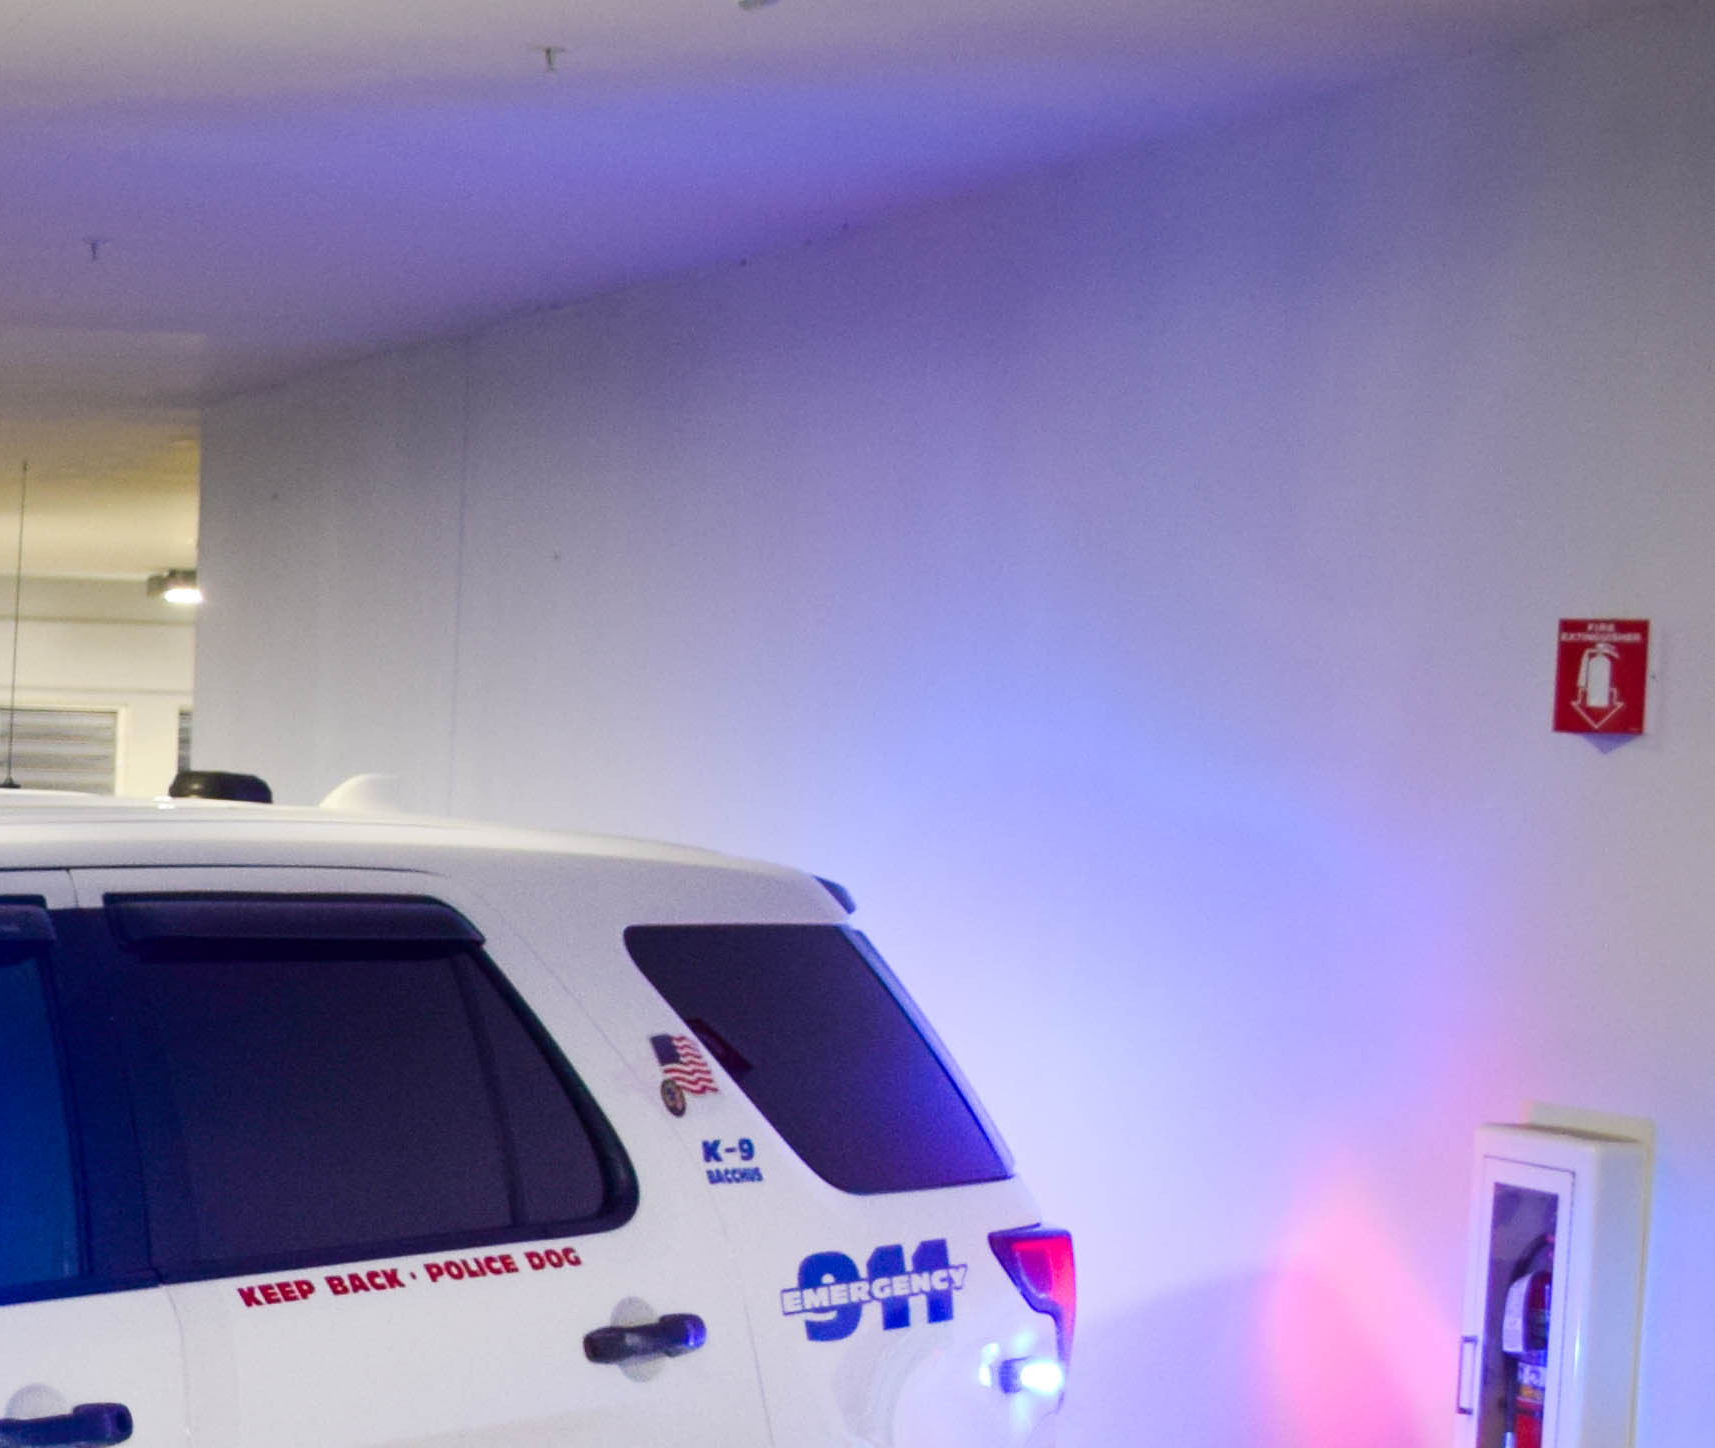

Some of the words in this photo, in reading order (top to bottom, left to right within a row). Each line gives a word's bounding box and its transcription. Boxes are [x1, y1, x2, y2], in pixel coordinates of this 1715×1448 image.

[702, 1137, 755, 1162] K-9
[237, 1279, 316, 1308] KEEP
[324, 1268, 406, 1296] BACK
[424, 1253, 519, 1283] POLICE
[524, 1246, 582, 1271] DOG
[780, 1264, 968, 1316] EMERGENCY
